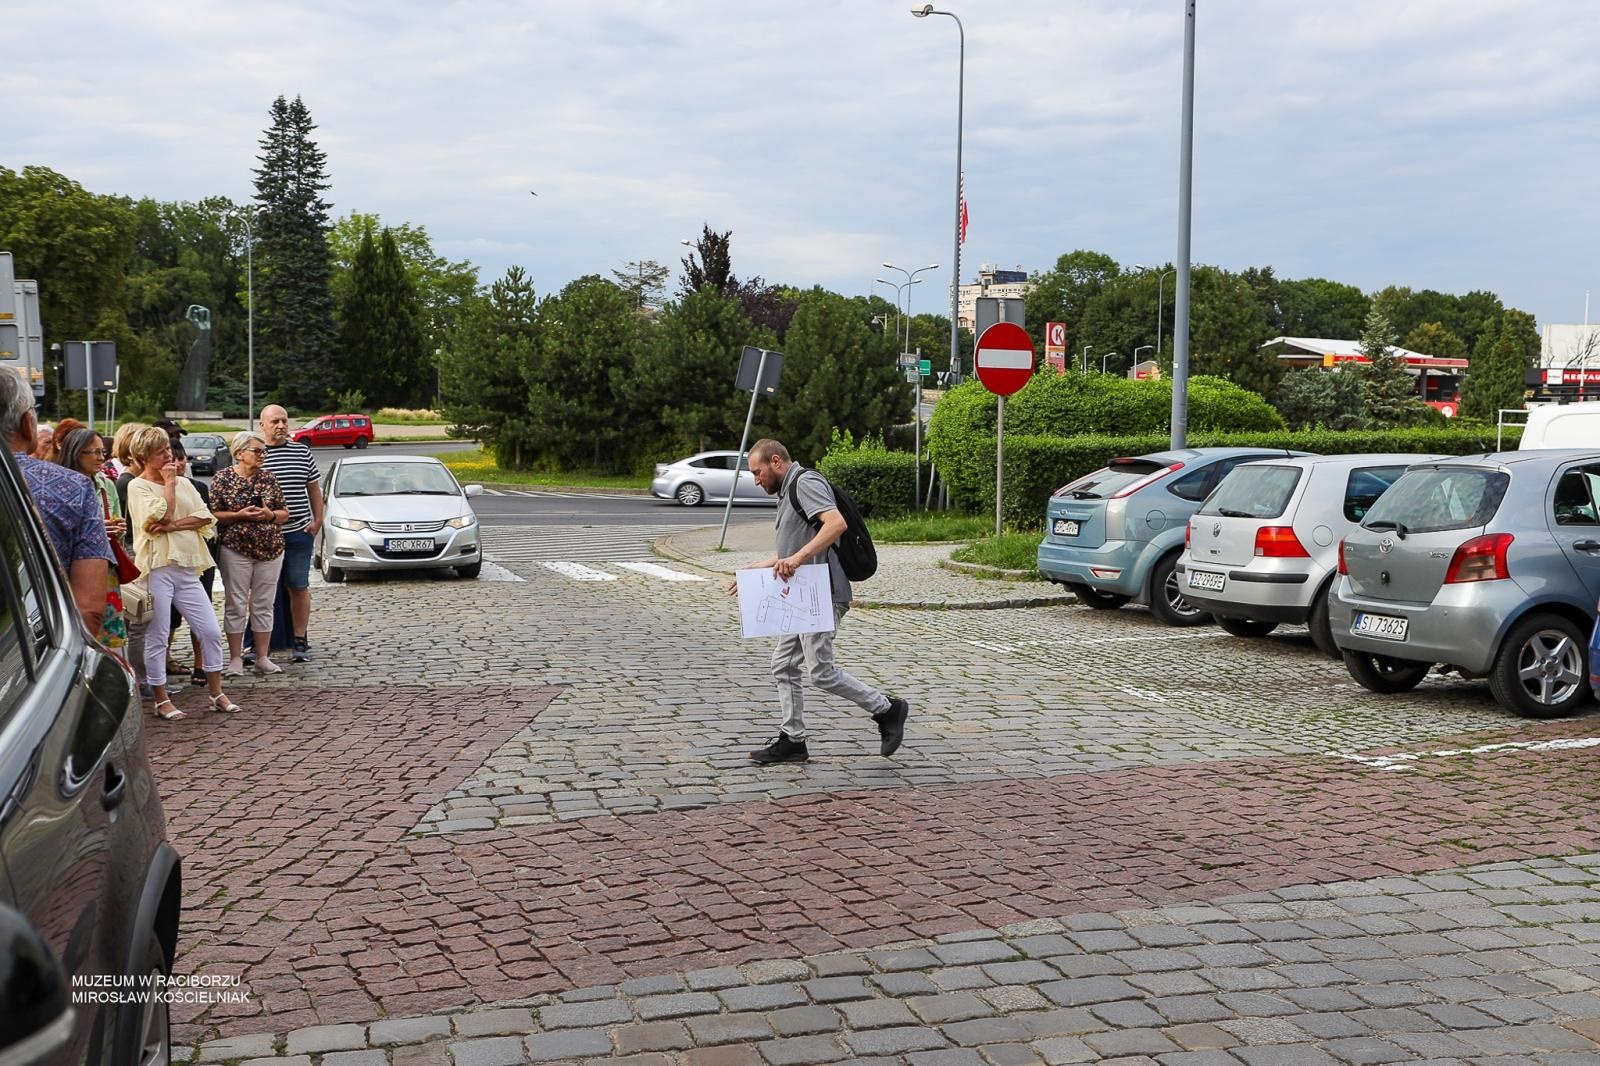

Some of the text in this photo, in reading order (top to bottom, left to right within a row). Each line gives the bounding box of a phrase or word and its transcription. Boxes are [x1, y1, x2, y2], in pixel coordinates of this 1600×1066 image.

[391, 540, 432, 549] SRC XR67
[1362, 615, 1406, 635] SI 73625
